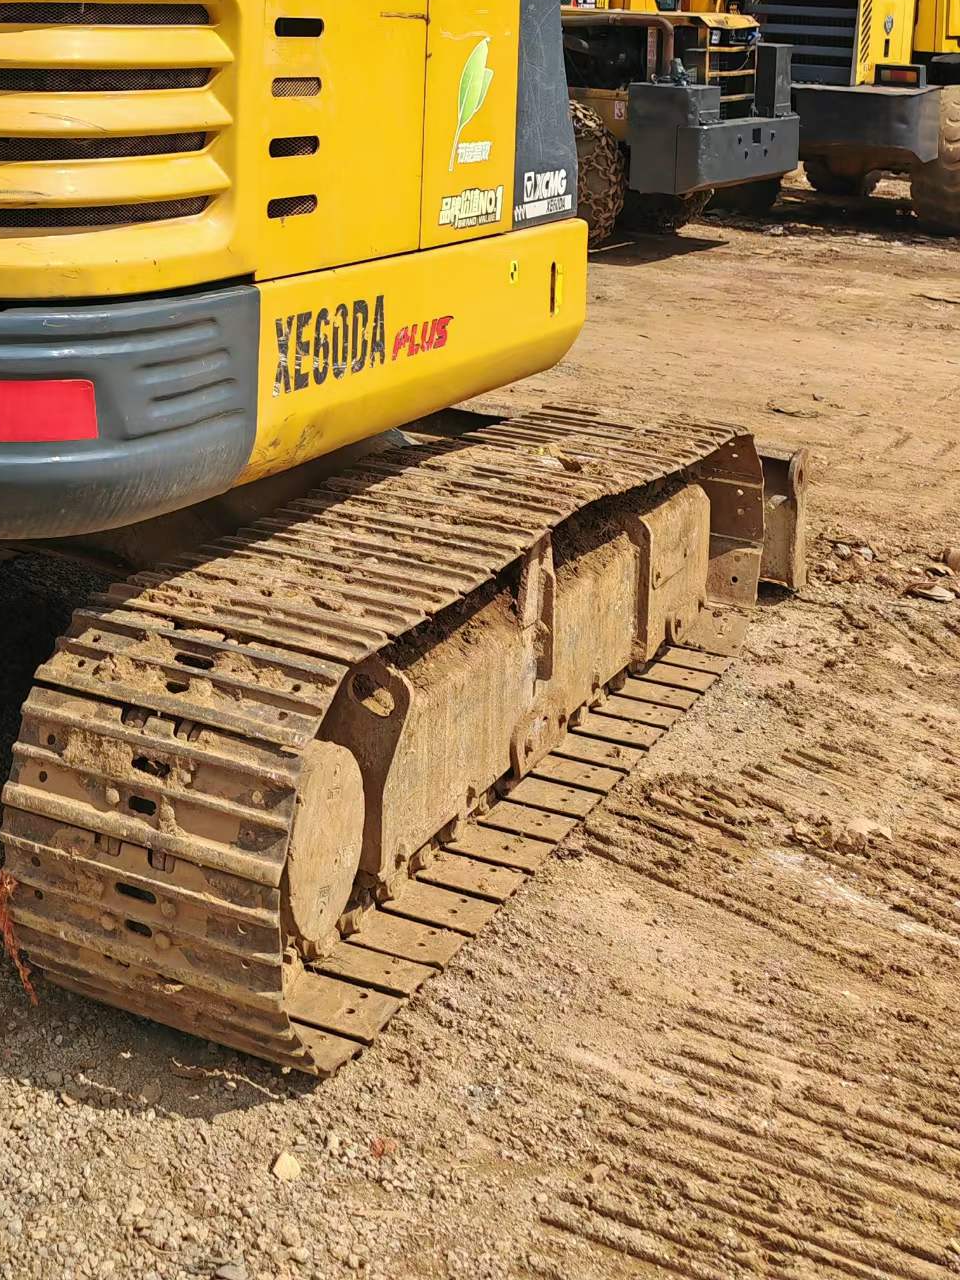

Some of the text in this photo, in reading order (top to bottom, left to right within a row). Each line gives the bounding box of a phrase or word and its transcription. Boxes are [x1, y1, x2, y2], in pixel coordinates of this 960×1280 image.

[533, 168, 567, 201] XCMG
[272, 294, 454, 398] XE60DA PLUS
